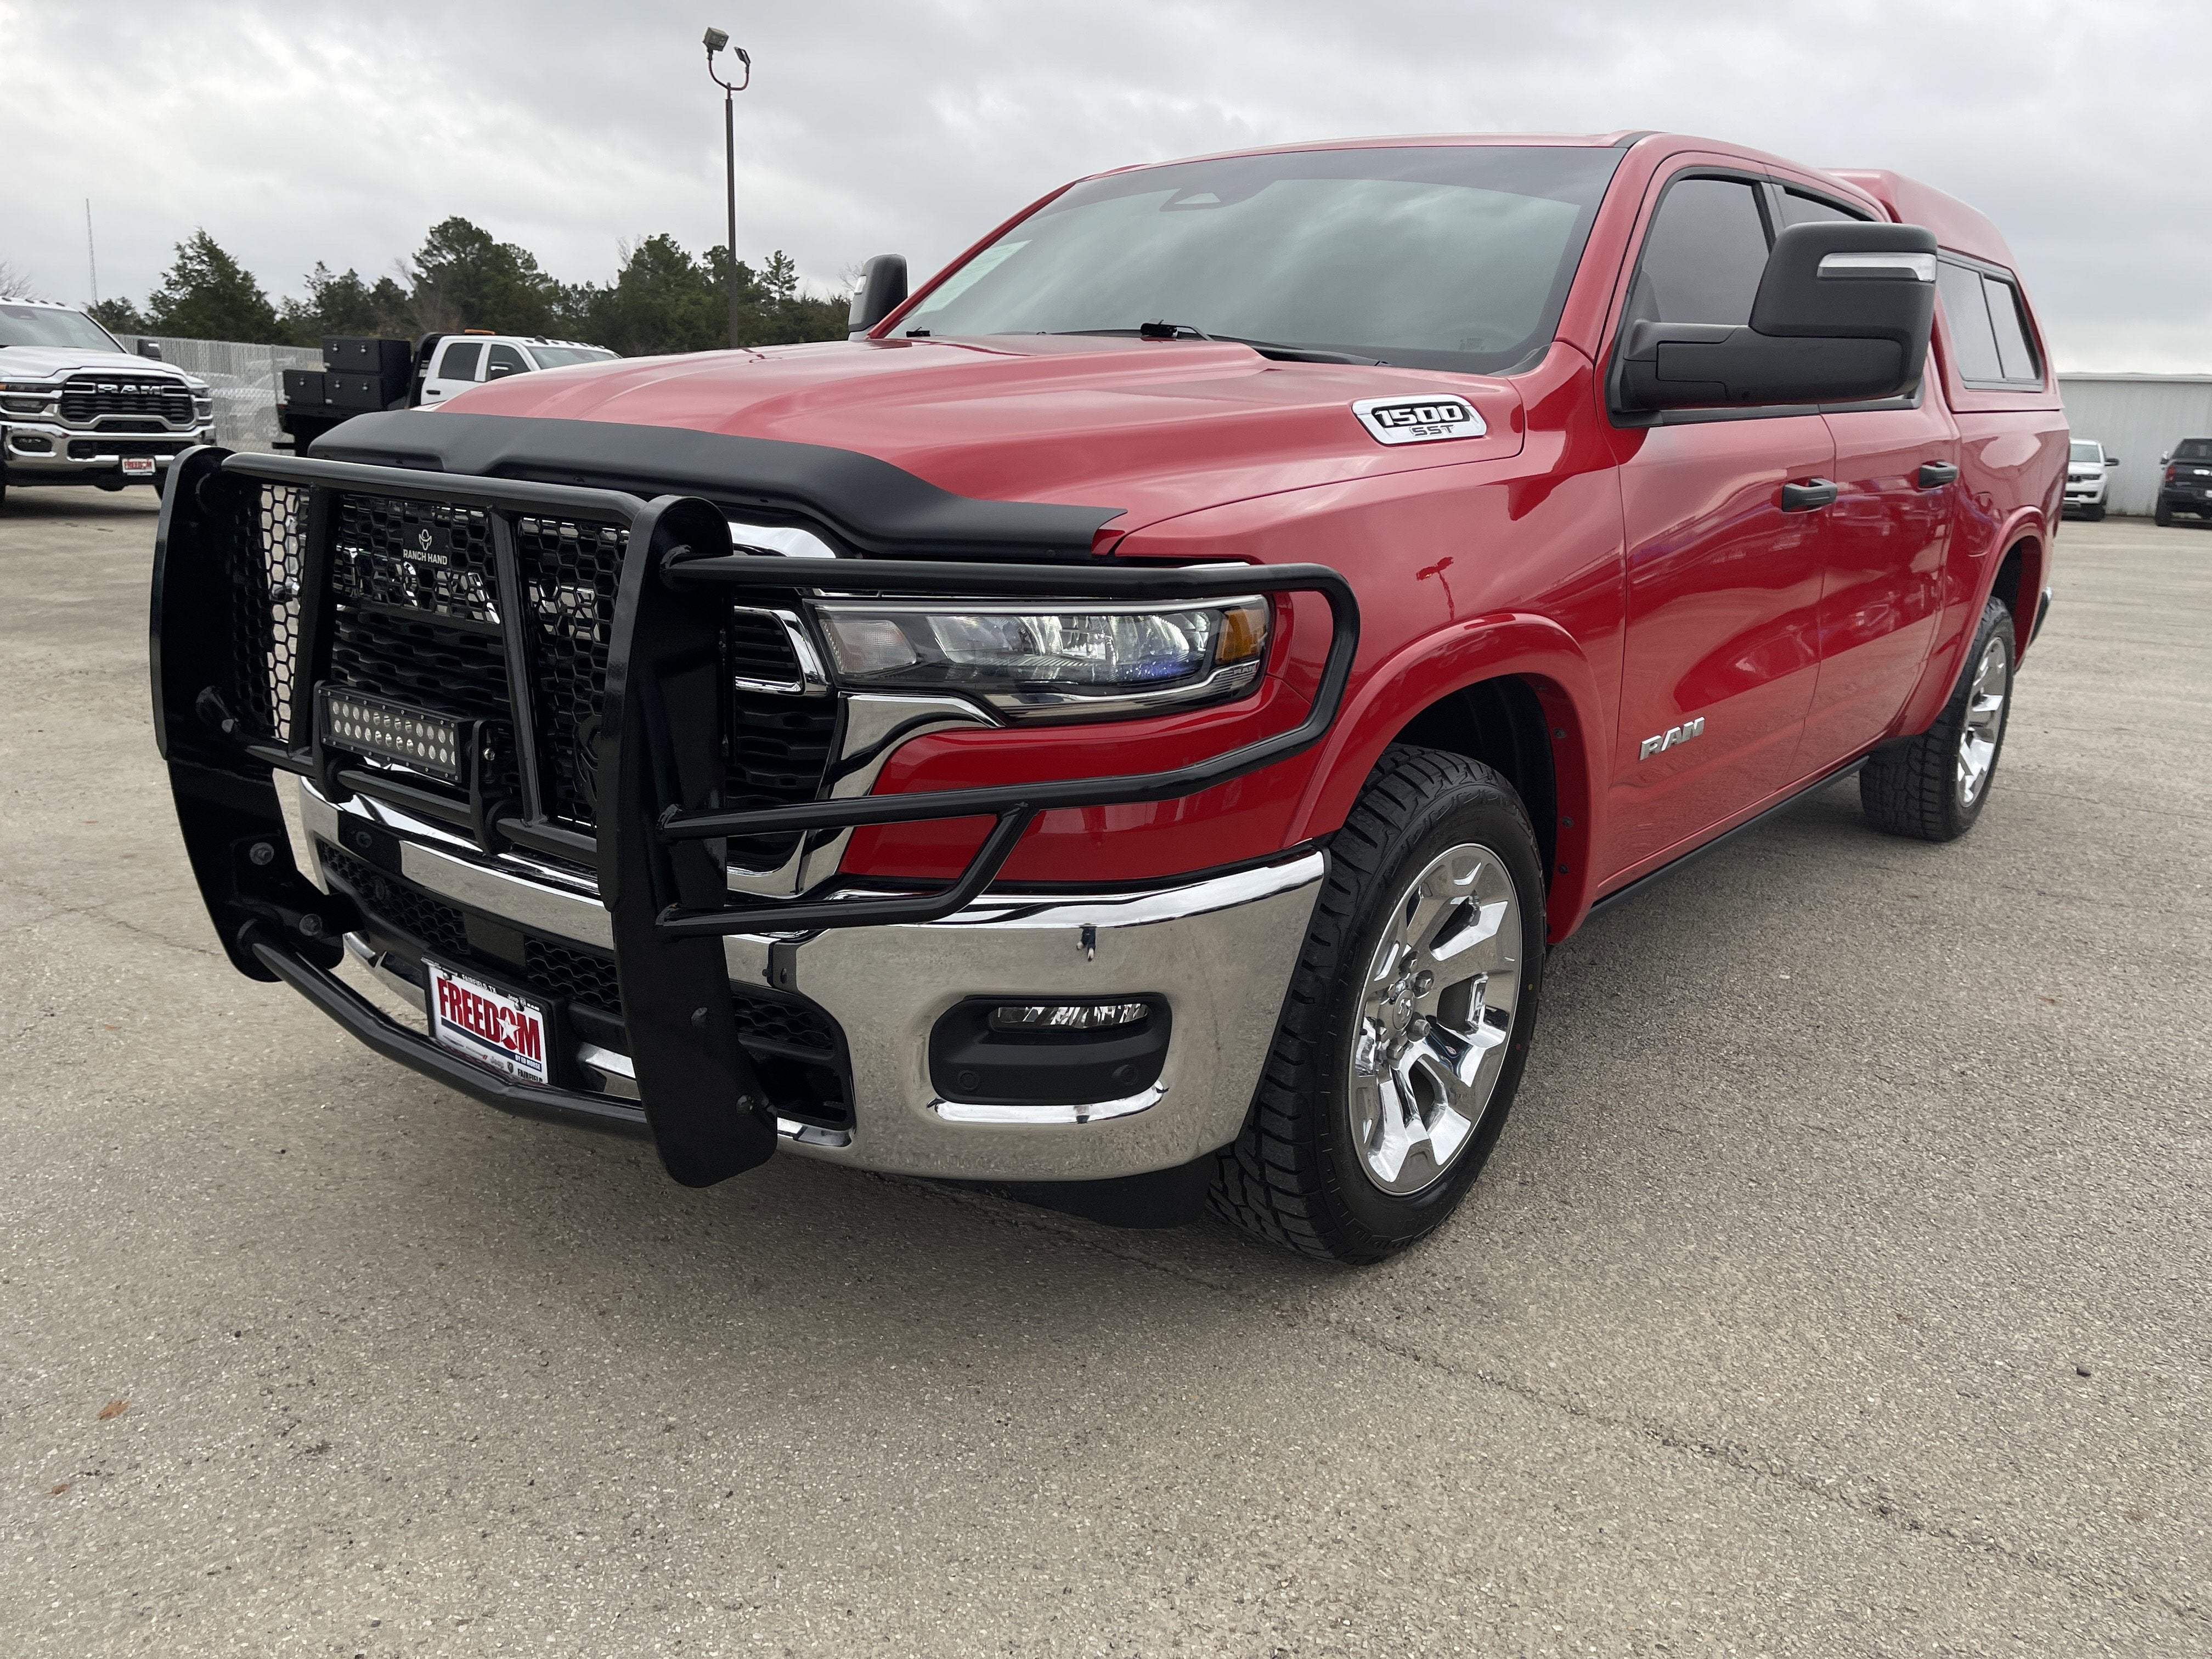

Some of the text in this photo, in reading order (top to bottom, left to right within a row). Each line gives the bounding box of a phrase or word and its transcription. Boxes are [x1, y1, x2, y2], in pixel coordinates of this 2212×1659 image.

[98, 384, 161, 394] RAM
[1374, 405, 1463, 426] 1500
[1410, 425, 1454, 437] SST
[124, 461, 152, 470] FREEDOM
[403, 549, 448, 565] RANCH HAND
[1639, 716, 1705, 761] RAM
[488, 985, 498, 994] TX
[437, 976, 541, 1062] FREEDOM
[490, 1056, 504, 1069] Jeep
[526, 1059, 541, 1070] MORSE
